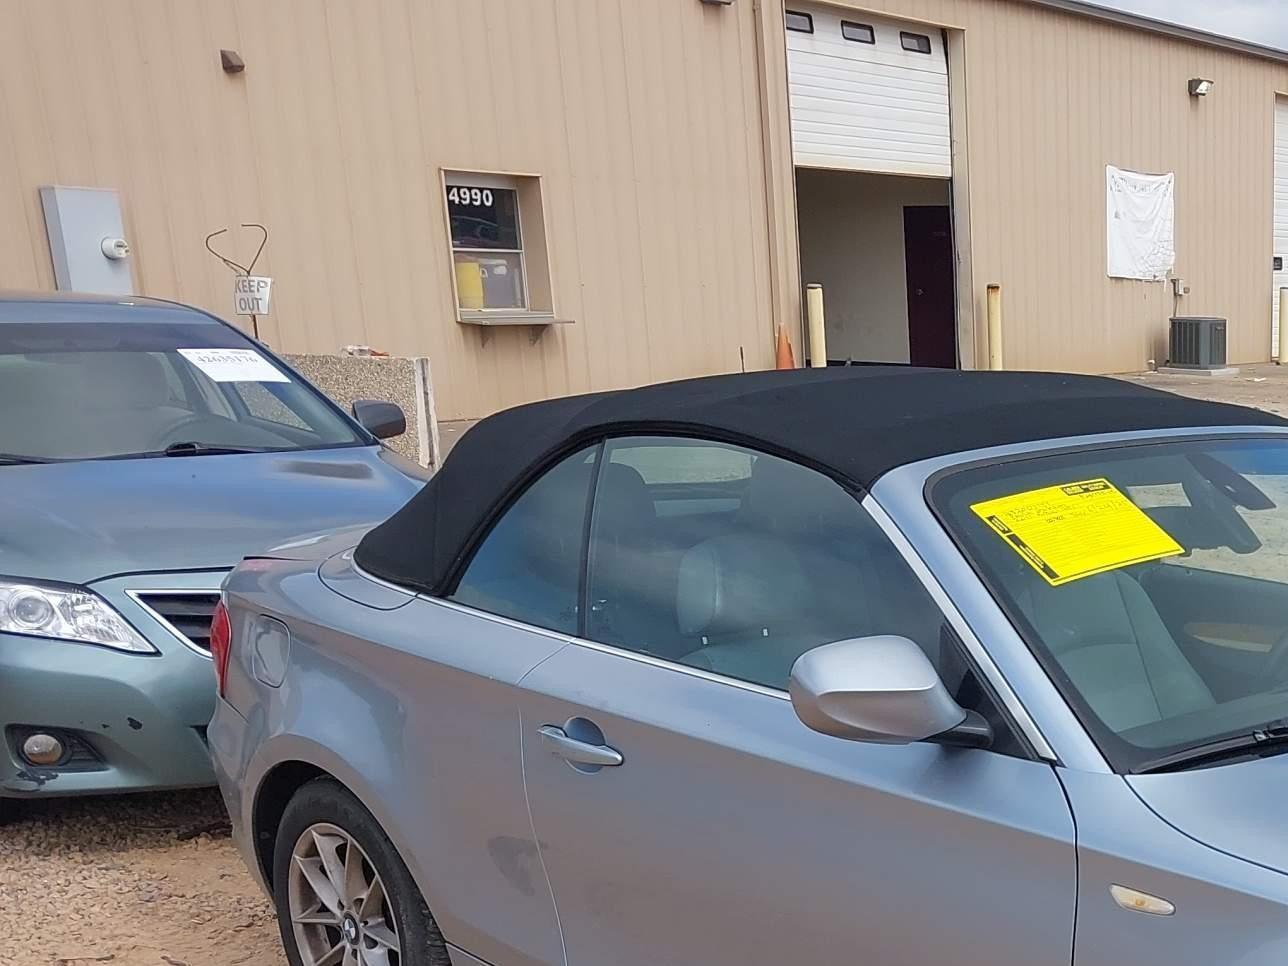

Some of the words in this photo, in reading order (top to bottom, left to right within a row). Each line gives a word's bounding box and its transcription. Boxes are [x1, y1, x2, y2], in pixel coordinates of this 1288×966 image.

[448, 187, 494, 206] 4990
[235, 279, 269, 293] KEEP
[239, 297, 262, 312] OUT
